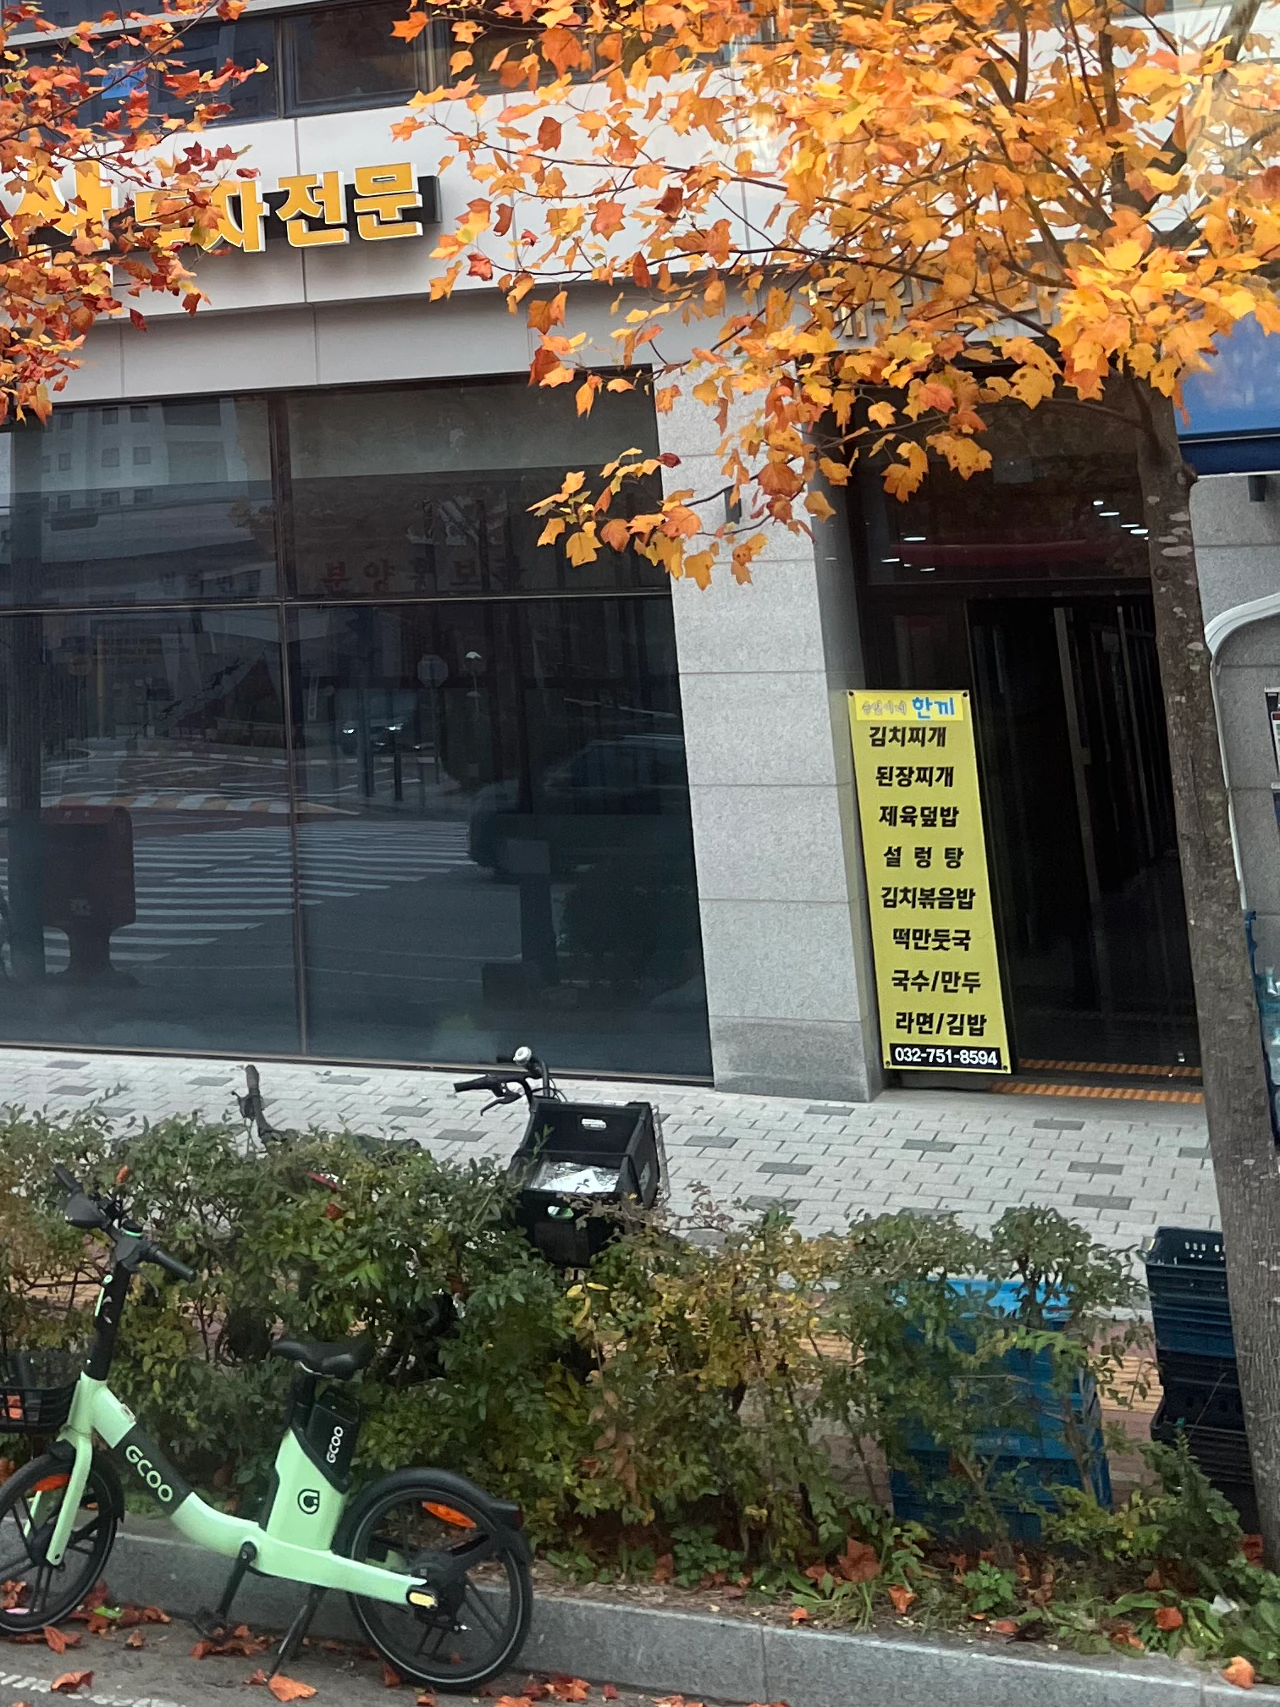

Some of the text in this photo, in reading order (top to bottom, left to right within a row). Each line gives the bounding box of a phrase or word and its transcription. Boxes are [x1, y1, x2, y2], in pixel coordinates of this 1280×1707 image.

[911, 696, 955, 720] 한끼
[868, 725, 947, 748] 김치찌개
[875, 765, 955, 788] 된장찌개
[878, 805, 959, 828] 제육덮밥
[880, 886, 976, 910] 김치볶음밥
[891, 969, 982, 994] 국수/만두
[894, 1011, 988, 1037] 라면/김밥
[894, 1047, 998, 1067] 032-751-8594
[325, 1424, 345, 1465] GCOO
[125, 1443, 174, 1504] GCOO
